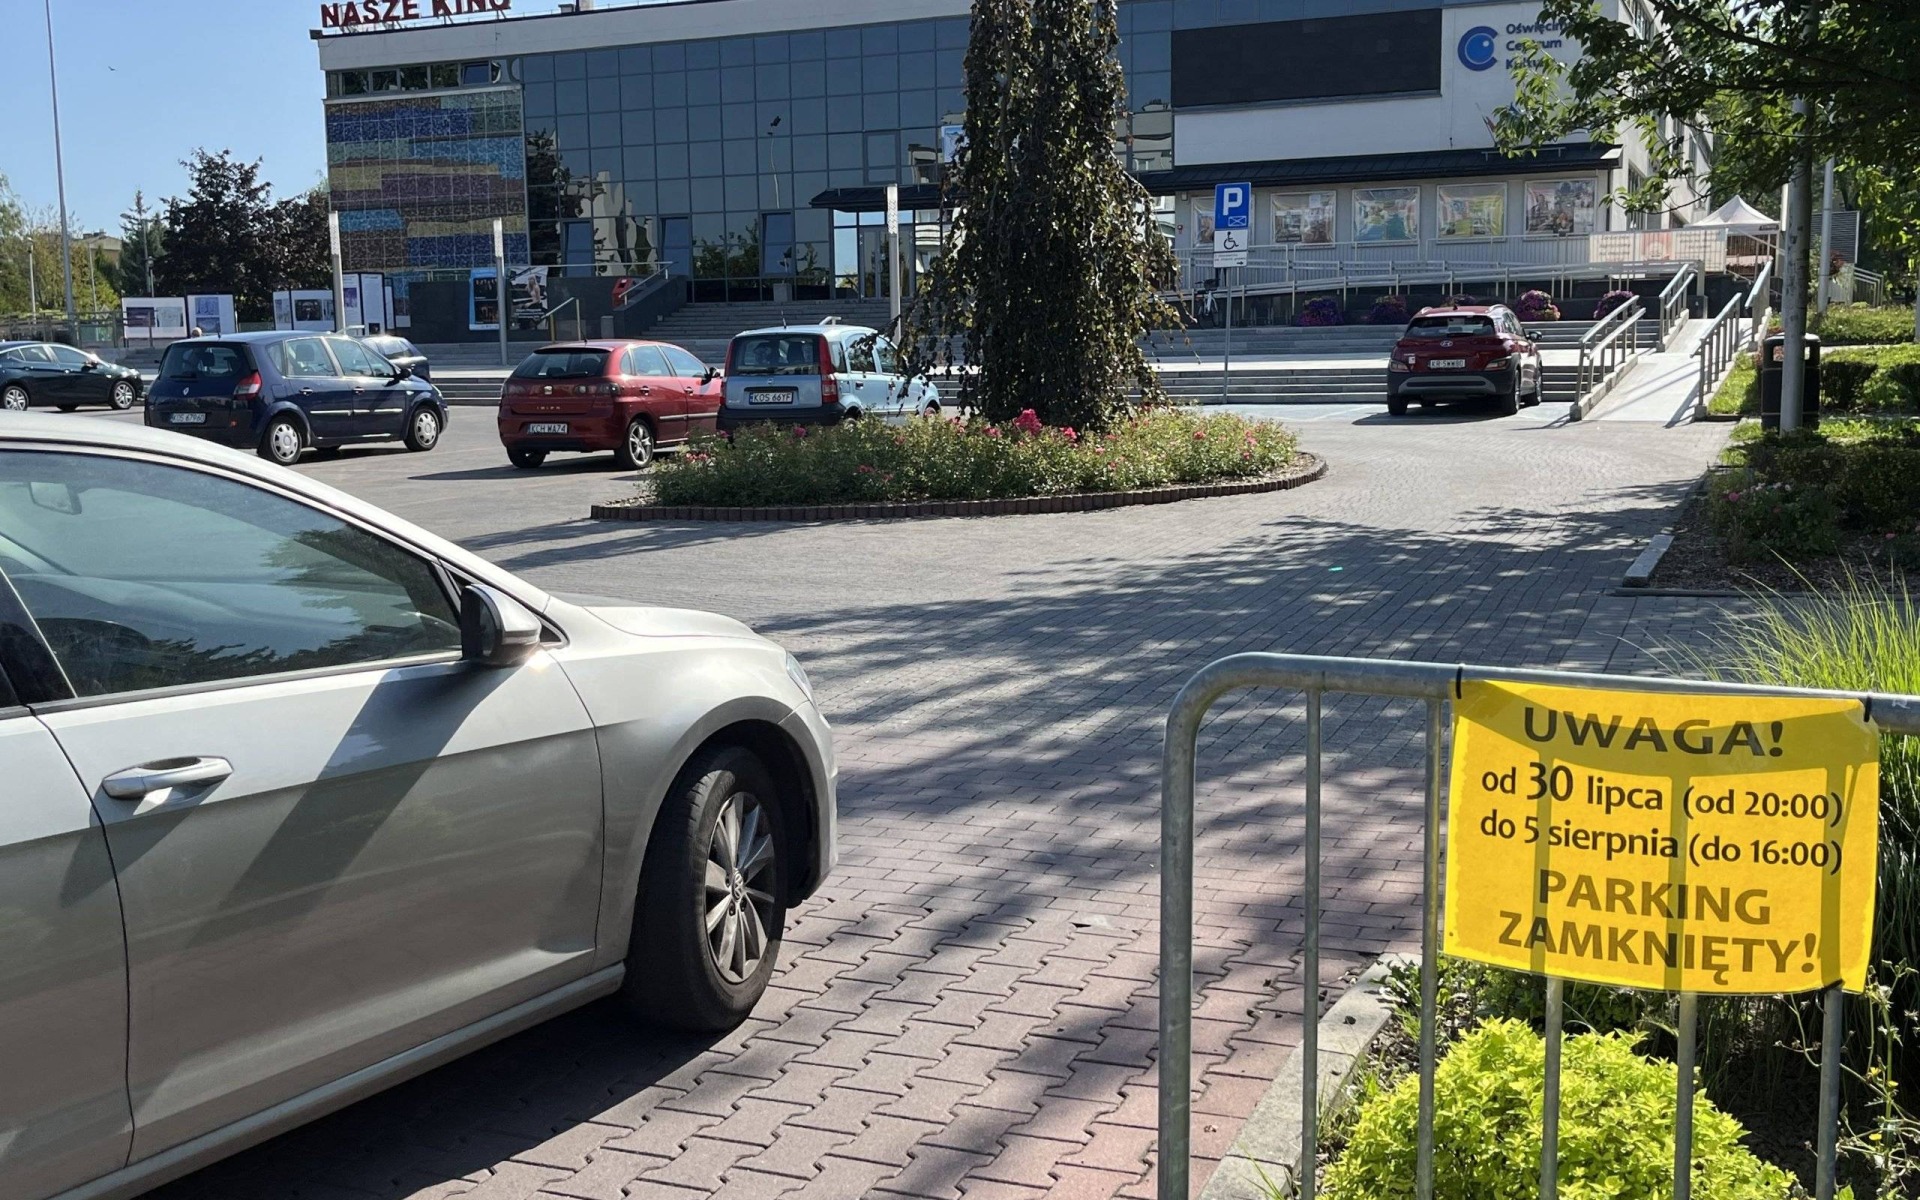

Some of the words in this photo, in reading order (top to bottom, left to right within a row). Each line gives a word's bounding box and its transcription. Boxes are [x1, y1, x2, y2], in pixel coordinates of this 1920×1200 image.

[321, 0, 419, 27] NASZE
[1222, 187, 1243, 216] P
[753, 393, 770, 402] KOS
[771, 393, 791, 402] 66YF
[531, 424, 545, 433] KCH
[1524, 707, 1783, 757] UWAGA!
[1481, 766, 1516, 795] od
[1526, 762, 1574, 801] 30
[1587, 775, 1664, 815] lipca
[1683, 785, 1735, 820] (od
[1744, 791, 1843, 828] 20:00)
[1480, 808, 1516, 839] do
[1524, 815, 1540, 843] 5
[1547, 819, 1678, 861] sierpnia
[1689, 833, 1741, 868] (do
[1750, 839, 1843, 876] 16:00)
[1539, 869, 1771, 925] PARKING
[1498, 910, 1817, 986] ZAMKNIĘTY!
